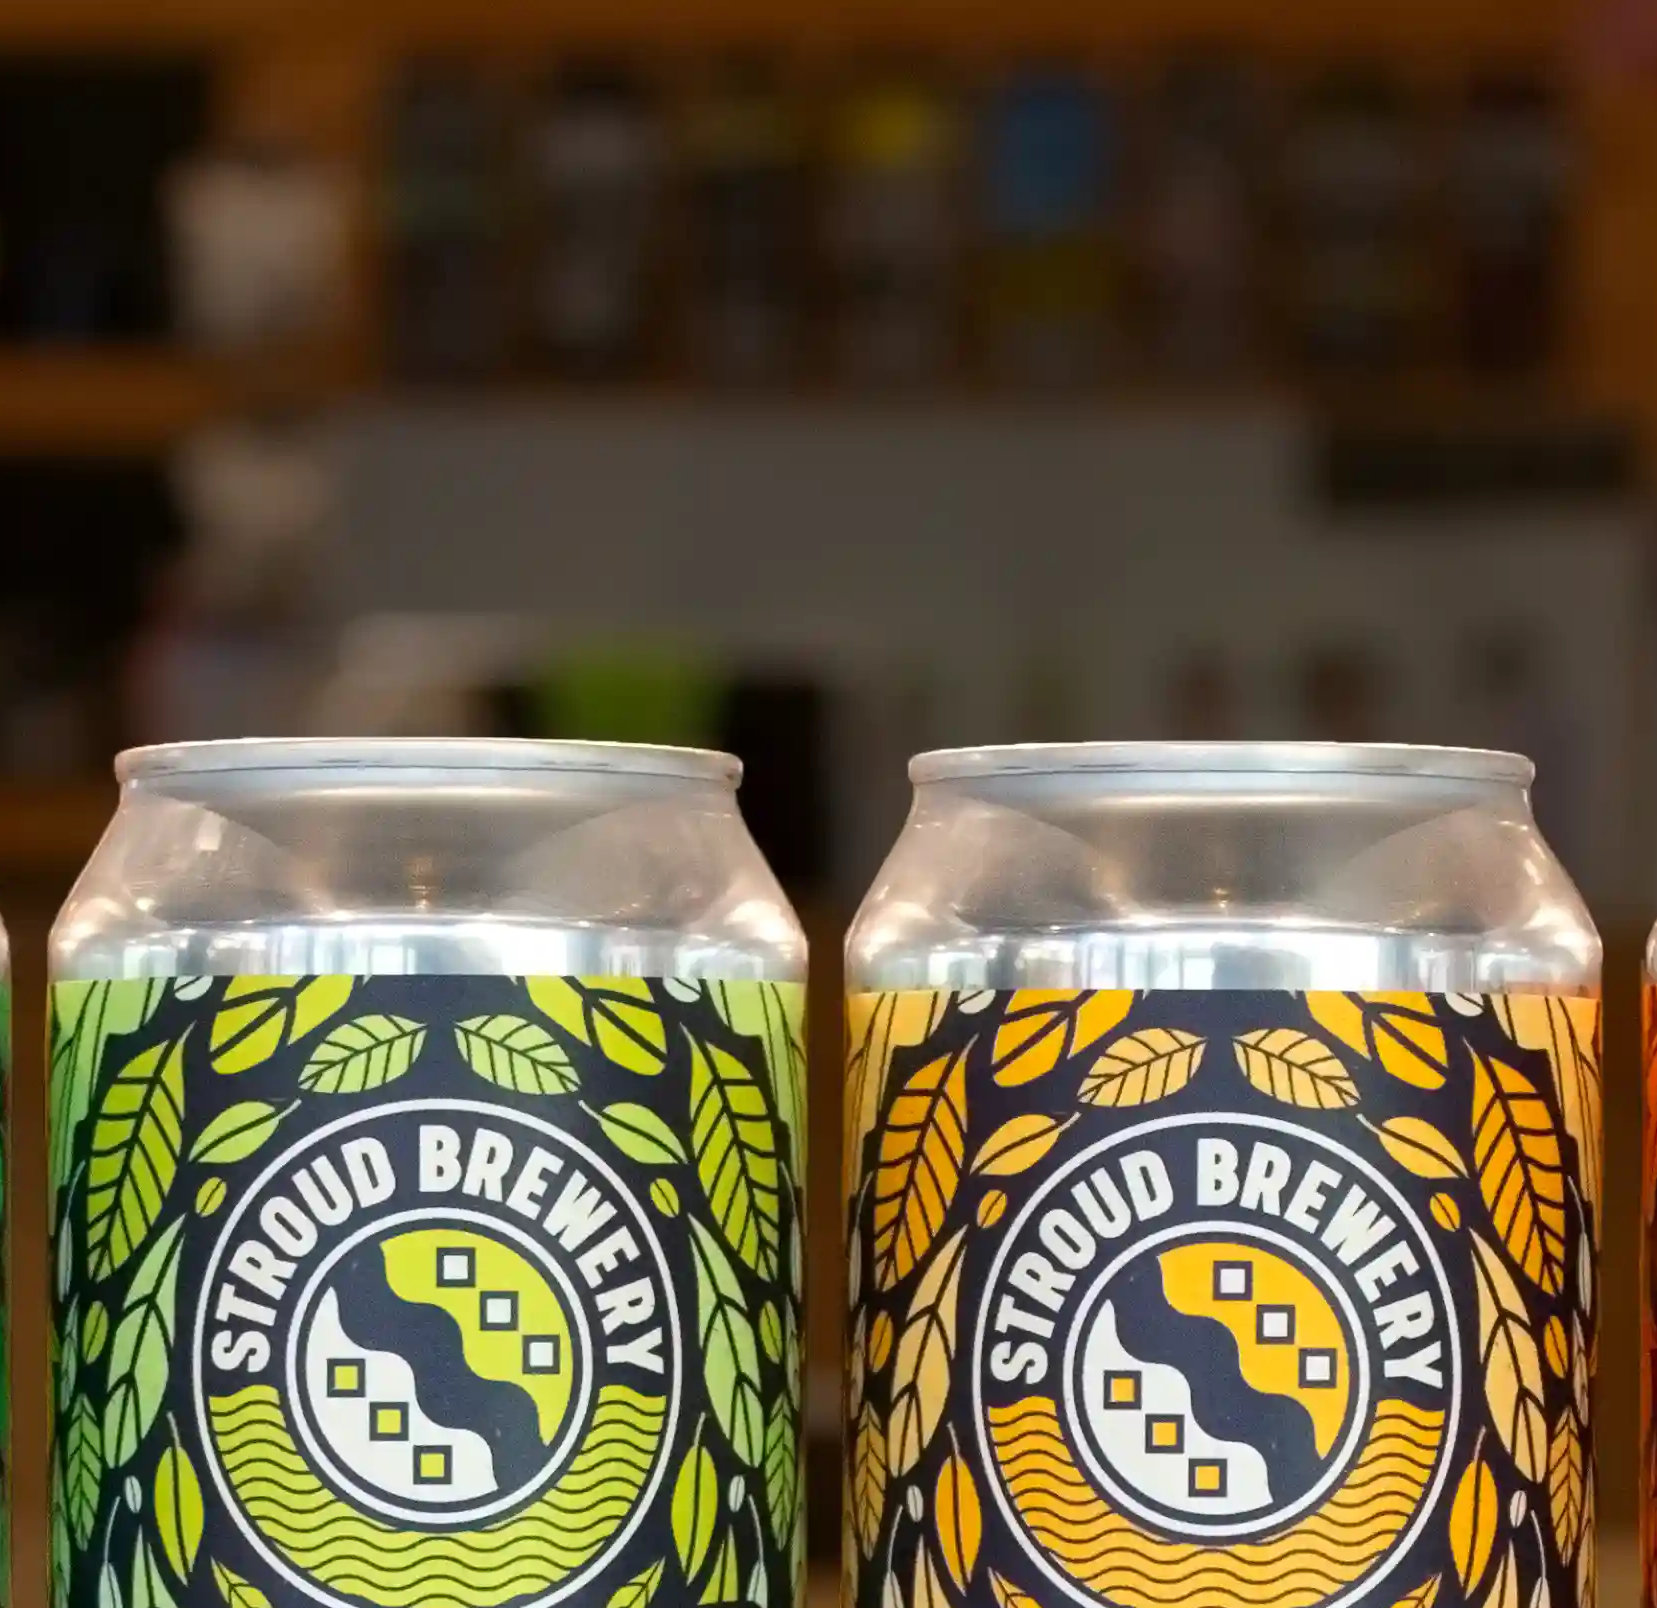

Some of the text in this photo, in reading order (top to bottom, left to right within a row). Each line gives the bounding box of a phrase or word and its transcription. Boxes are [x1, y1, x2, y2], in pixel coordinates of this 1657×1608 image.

[211, 1124, 666, 1374] STROUD BREWERY
[990, 1137, 1443, 1389] STROUD BREWERY
